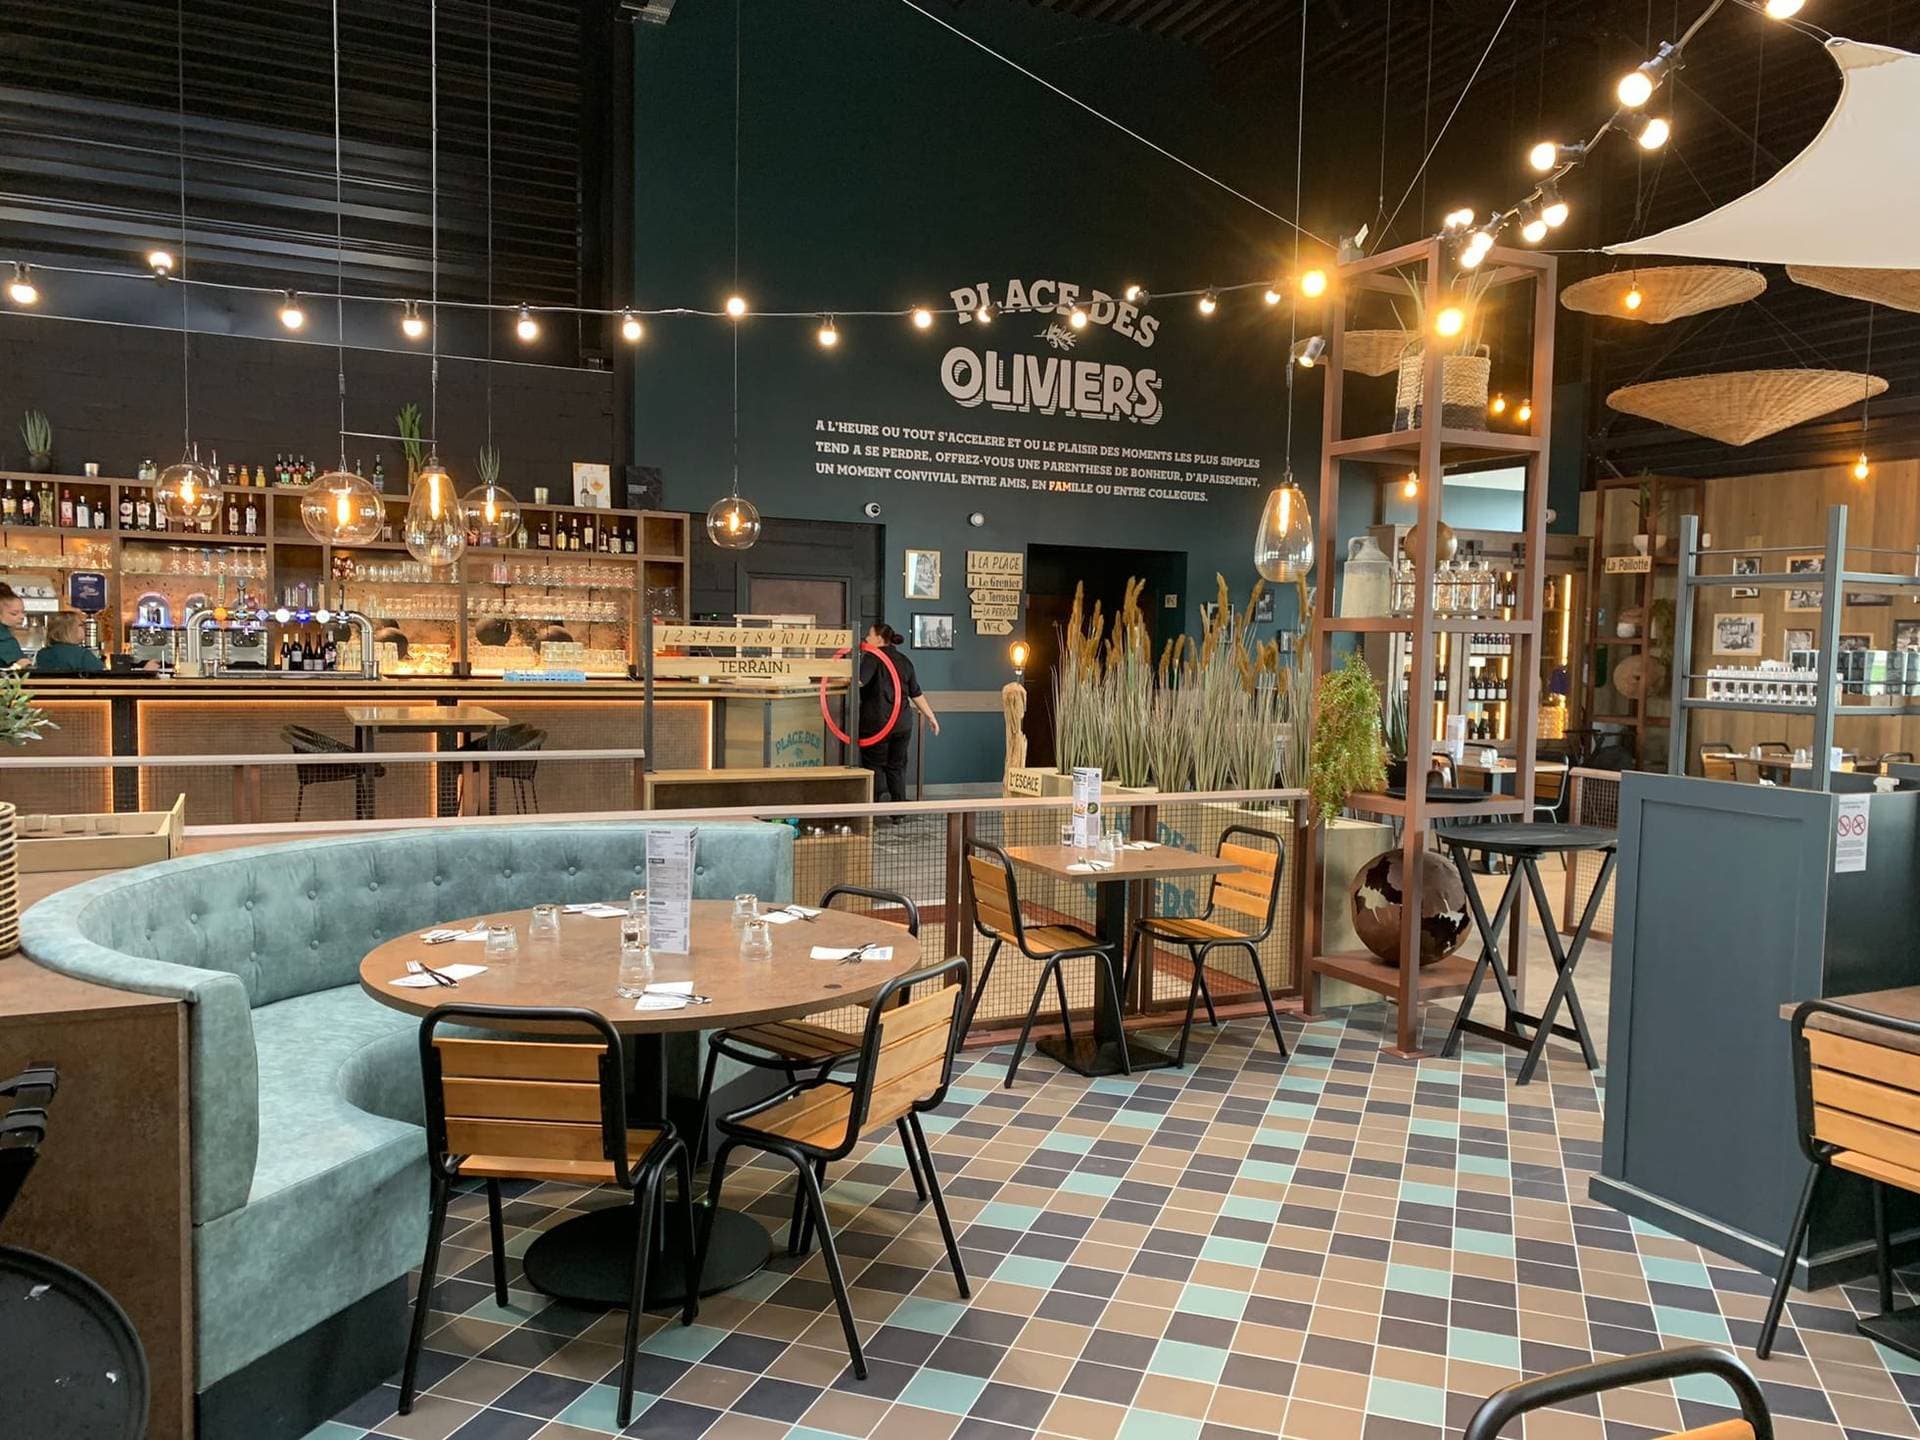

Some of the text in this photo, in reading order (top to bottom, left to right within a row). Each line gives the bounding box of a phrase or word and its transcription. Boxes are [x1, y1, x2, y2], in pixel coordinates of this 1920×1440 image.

[951, 279, 1160, 348] PLACE DES
[941, 346, 1163, 425] OLIVIERS
[816, 420, 1260, 468] A L'HEURE OU TOUT S'ACCELERE ET OU LE PLAISIR DES MOMENTS LES PLUS SIMPLES
[816, 441, 1261, 488] TEND A SE PERDRE, OFFREZ-VOUS UNE PARENTHESE DE BONHEUR, D'APAISEMENT,
[816, 463, 1208, 502] UN MOMENT CONVIVIAL ENTRE AMIS, EN FAMILLE OU ENTRE COLLEGUES.
[978, 556, 1019, 570] LA PLACE
[1606, 559, 1616, 571] La
[979, 577, 1020, 588] Le Grenier
[977, 591, 1018, 602] La Terrasse
[661, 630, 846, 646] 1 2 3 4 5 6 7 8 9 10 11 12 13
[719, 660, 784, 674] TERRAIN
